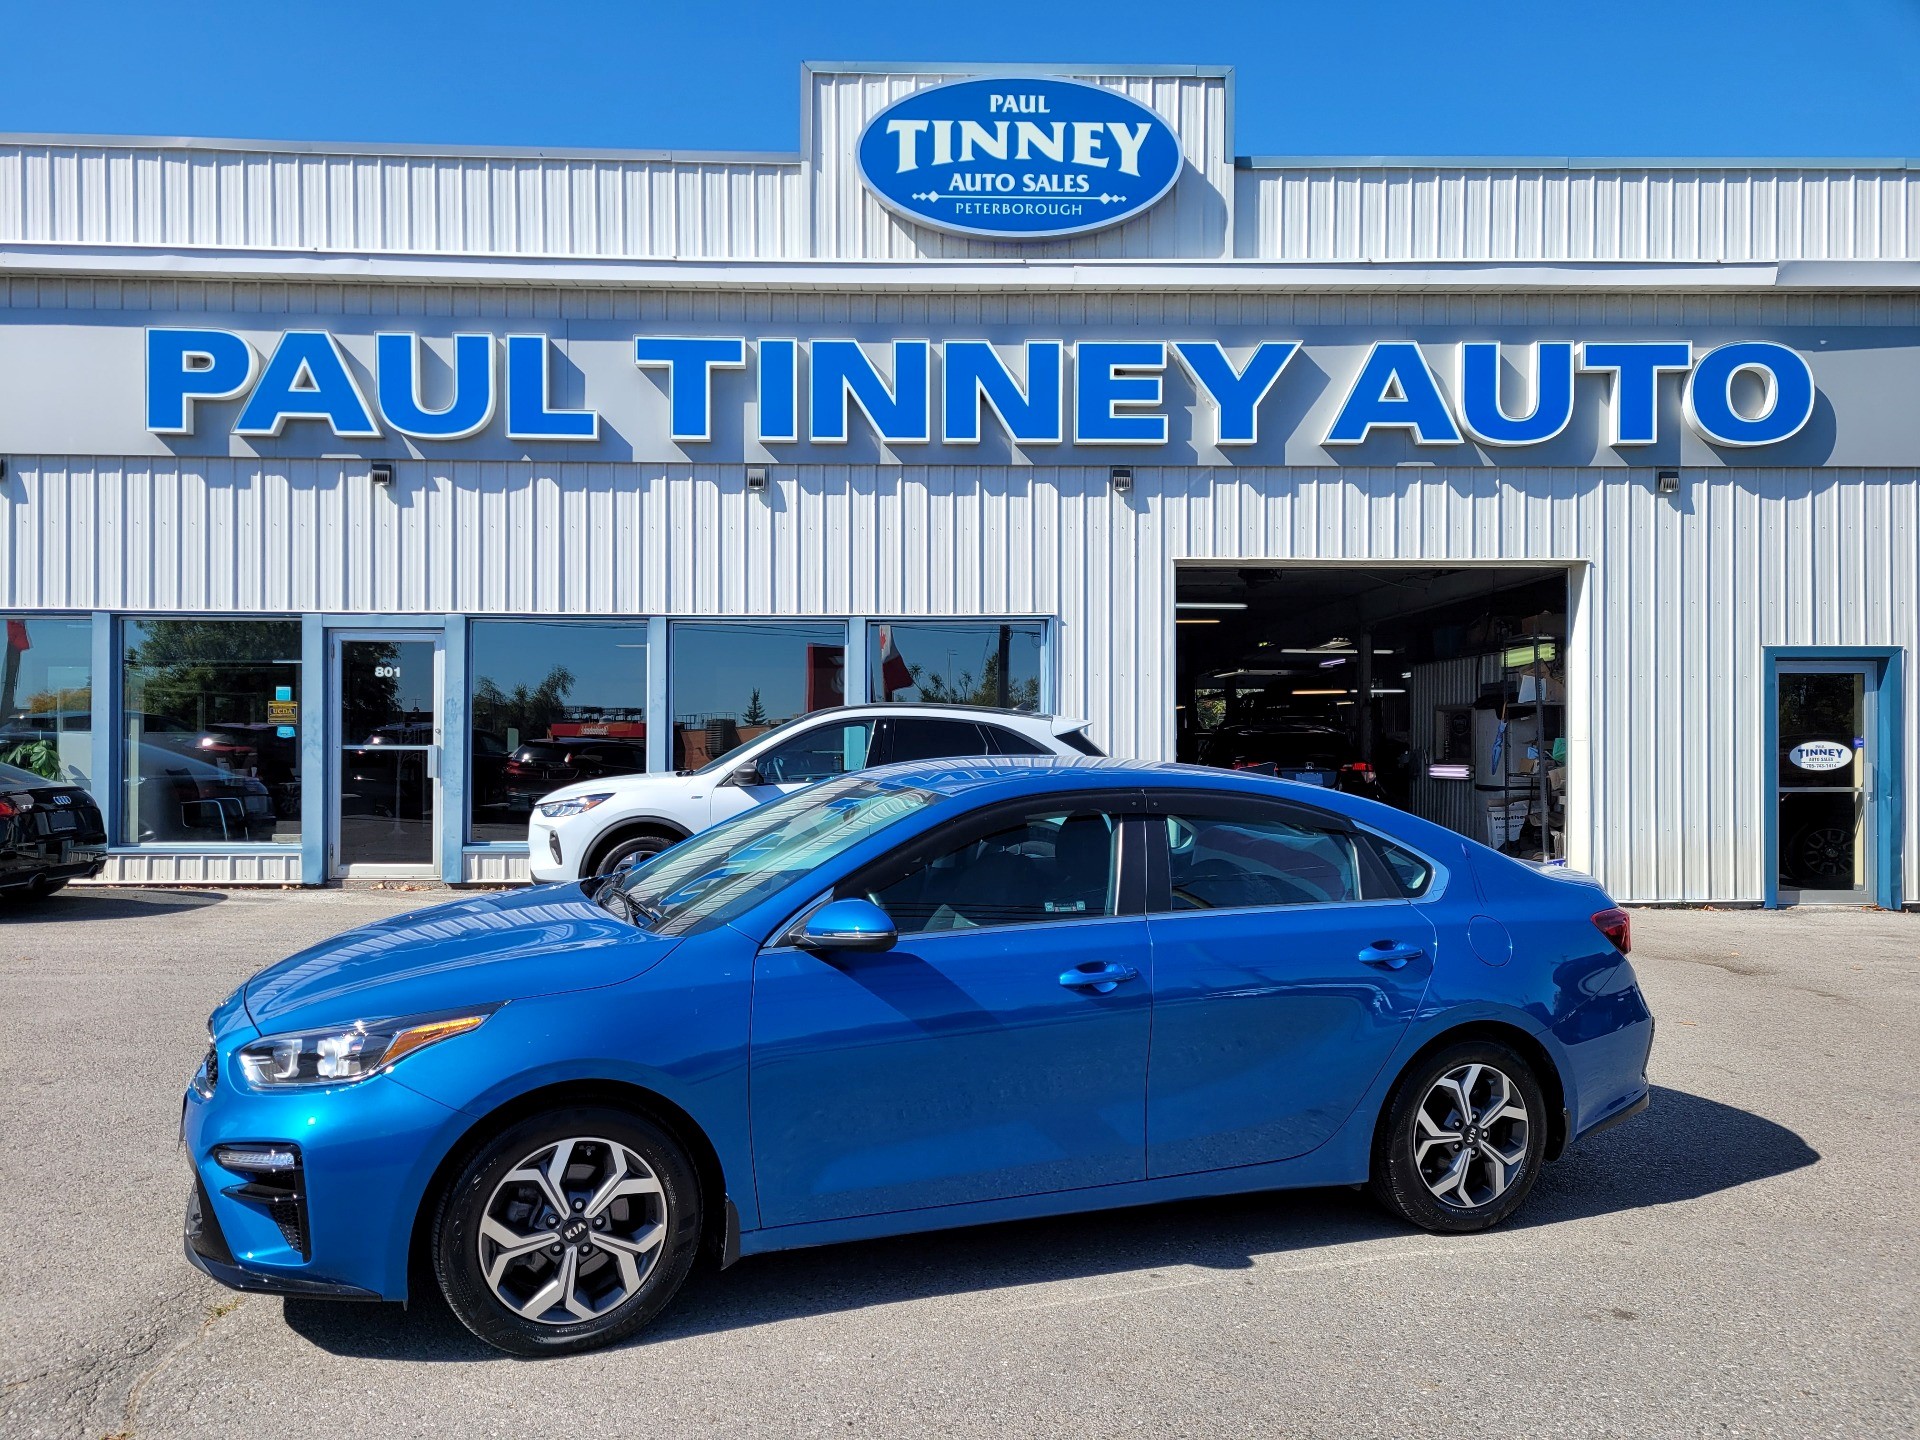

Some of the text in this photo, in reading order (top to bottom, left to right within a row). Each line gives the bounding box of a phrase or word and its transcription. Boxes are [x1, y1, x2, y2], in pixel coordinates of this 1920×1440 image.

[989, 94, 1050, 114] PAUL
[885, 119, 1152, 177] TINNEY
[948, 173, 1090, 193] AUTO SALES
[955, 202, 1083, 216] PETERBOROUGH
[144, 326, 1816, 448] PAUL TINNEY AUTO
[374, 666, 401, 678] 801
[1797, 749, 1843, 758] TINNEY
[1467, 1127, 1476, 1143] KIA
[564, 1222, 587, 1240] KIA
